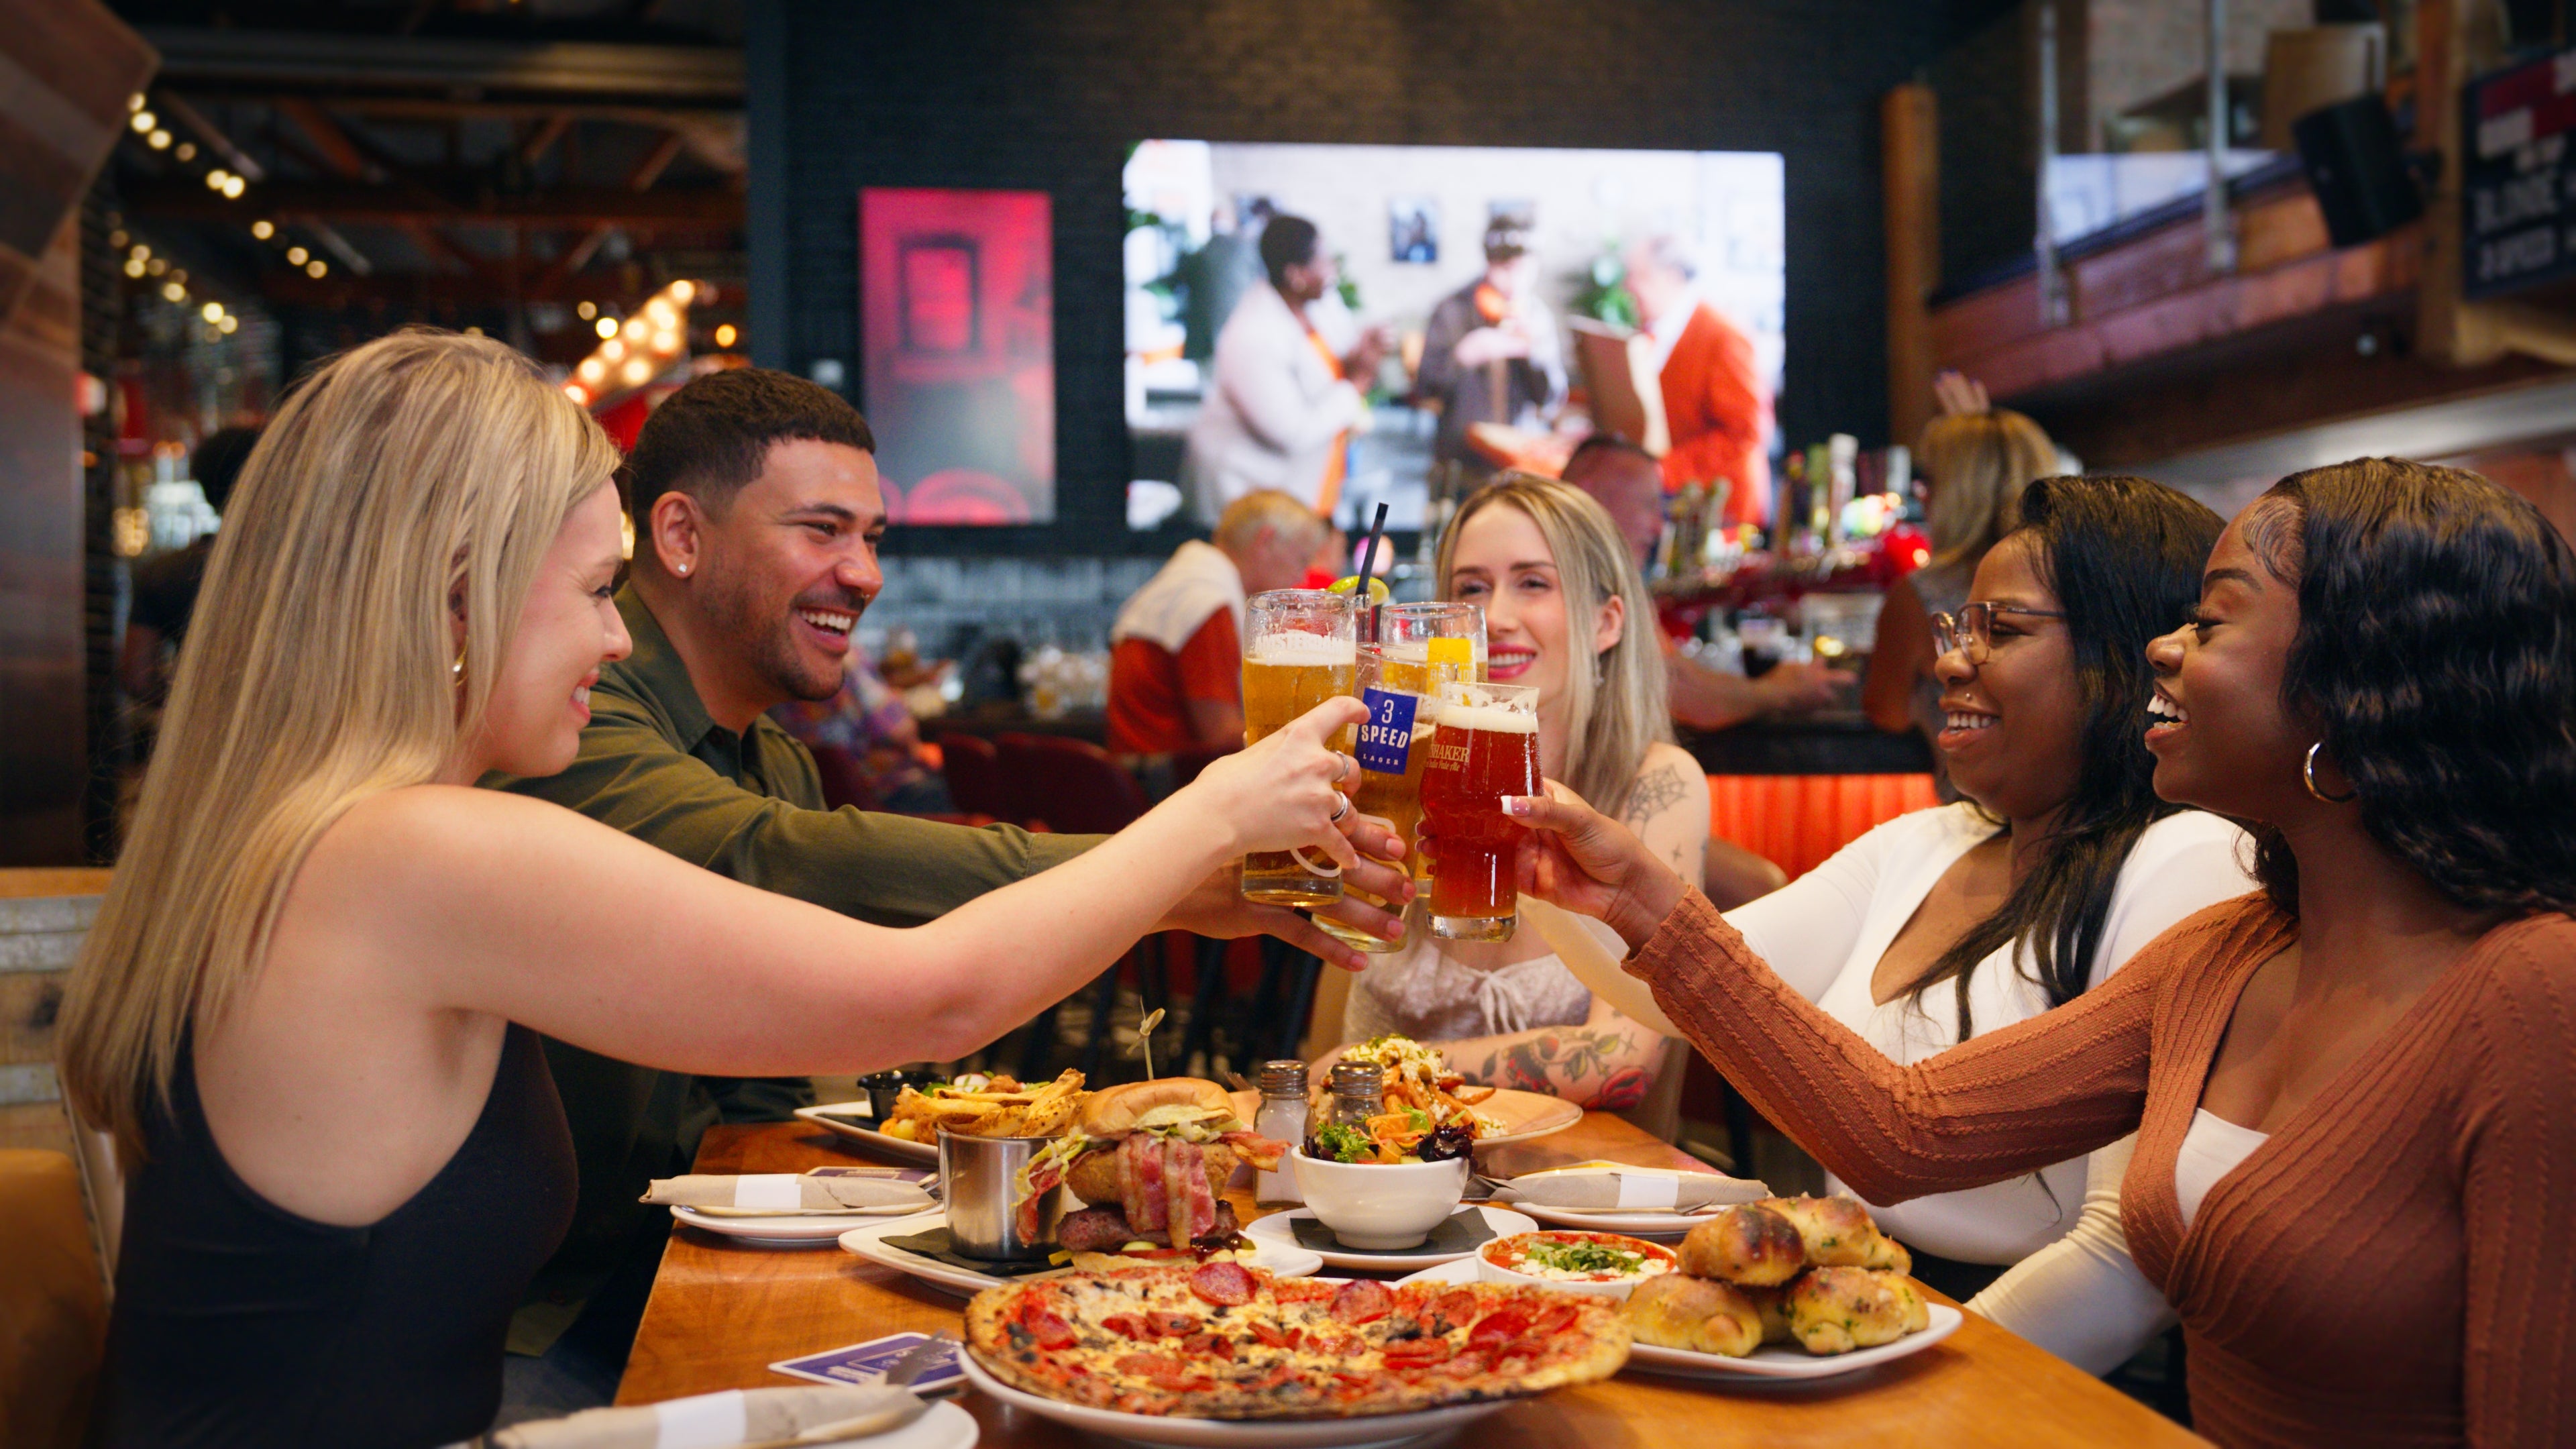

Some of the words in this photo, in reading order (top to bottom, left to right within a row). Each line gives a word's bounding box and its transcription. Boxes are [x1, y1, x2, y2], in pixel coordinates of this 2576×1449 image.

[1381, 699, 1395, 724] 3
[1361, 724, 1409, 749] SPEED
[1363, 753, 1399, 765] LAGER
[1438, 760, 1449, 770] Pale
[1450, 761, 1460, 771] Ale
